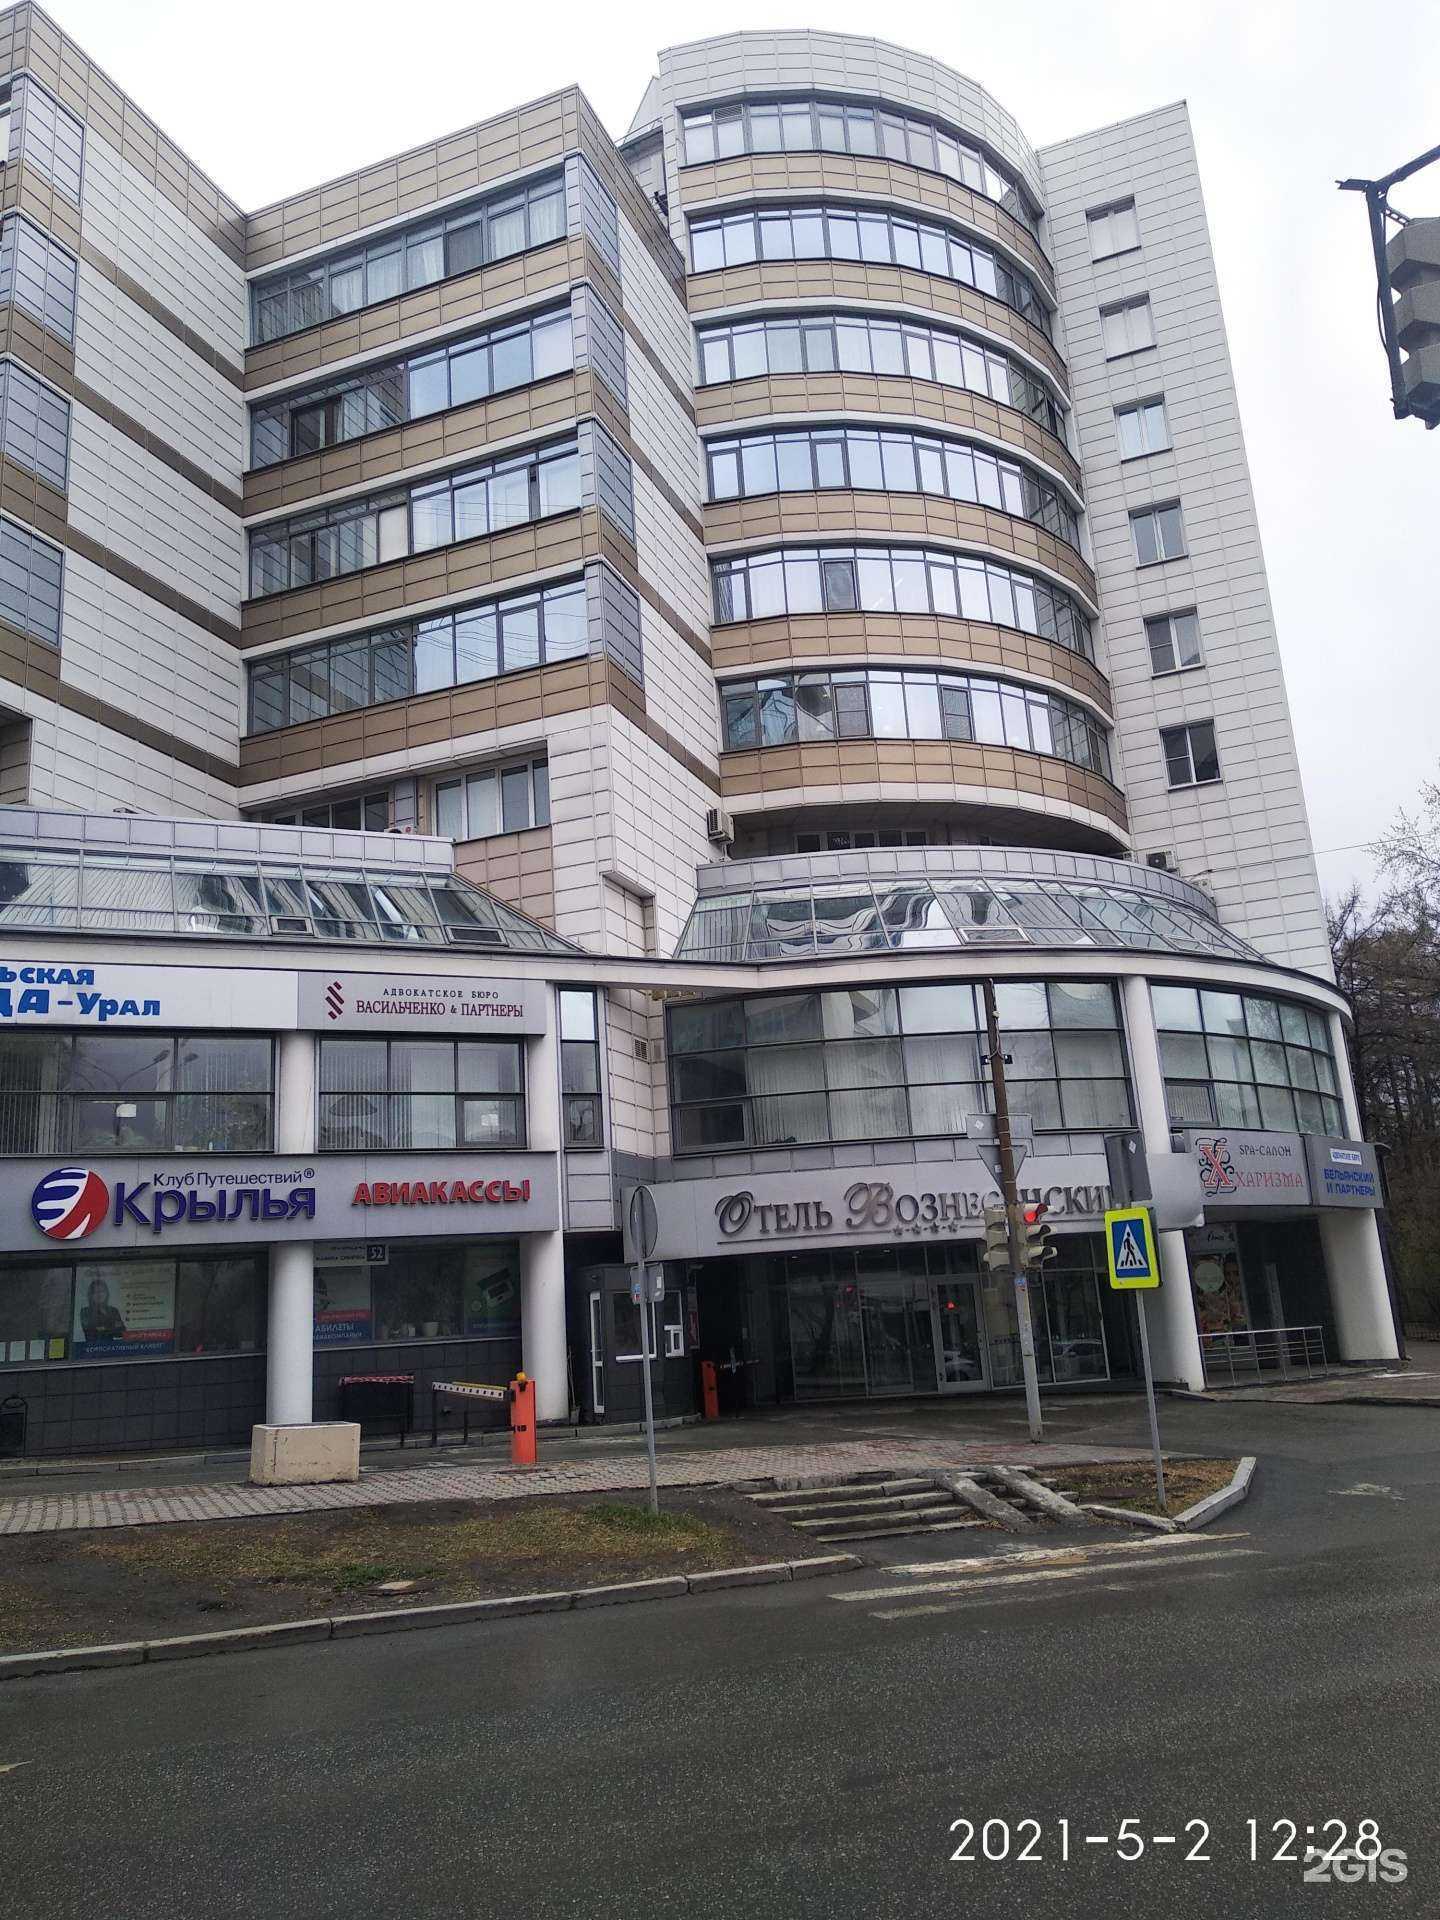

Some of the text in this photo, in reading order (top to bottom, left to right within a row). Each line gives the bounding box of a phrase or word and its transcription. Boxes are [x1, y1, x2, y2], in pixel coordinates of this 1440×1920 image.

[383, 987, 499, 1000] АДВОКАТСКОЕ БЮРО
[355, 1000, 524, 1018] ВАСИЛЬЧЕНКО & ПАРТНЕРЫ
[153, 1172, 195, 1189] Клуб
[1235, 1170, 1304, 1188] ХАРИЗМА
[351, 1179, 532, 1207] АВИАКАССЫ
[1335, 1183, 1376, 1197] ПАРТНЕРЫ
[112, 1180, 317, 1234] Крылья
[370, 1245, 385, 1260] 52
